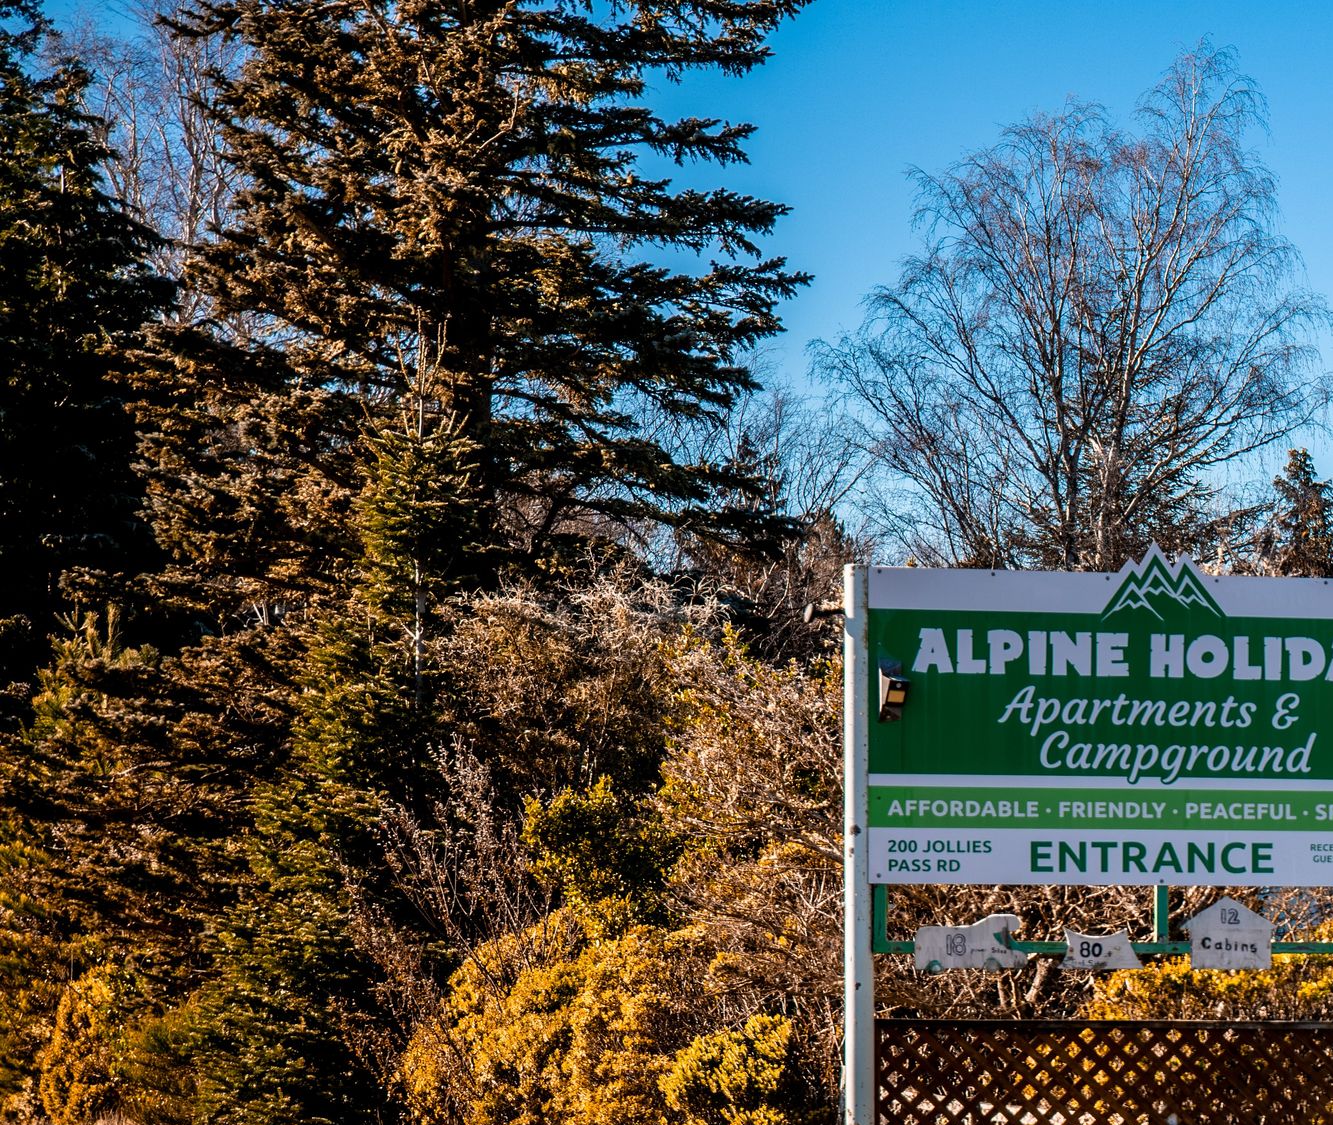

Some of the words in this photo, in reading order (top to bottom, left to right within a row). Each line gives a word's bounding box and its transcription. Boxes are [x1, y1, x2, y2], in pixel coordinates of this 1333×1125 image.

[911, 627, 1130, 678] ALPINE
[997, 685, 1257, 737] Apartments
[1271, 692, 1301, 730] &
[1039, 730, 1318, 784] Campground
[887, 799, 1040, 818] AFFORDABLE
[1058, 801, 1166, 819] FRIENDLY
[1185, 802, 1297, 821] PEACEFUL
[887, 839, 918, 853] 200
[922, 839, 993, 854] JOLLIES
[1029, 840, 1275, 875] ENTRANCE
[887, 858, 932, 872] PASS
[936, 858, 961, 873] RD
[1220, 908, 1241, 925] 12
[945, 933, 967, 957] 18
[1079, 941, 1103, 958] 80
[1201, 936, 1258, 953] Cabins
